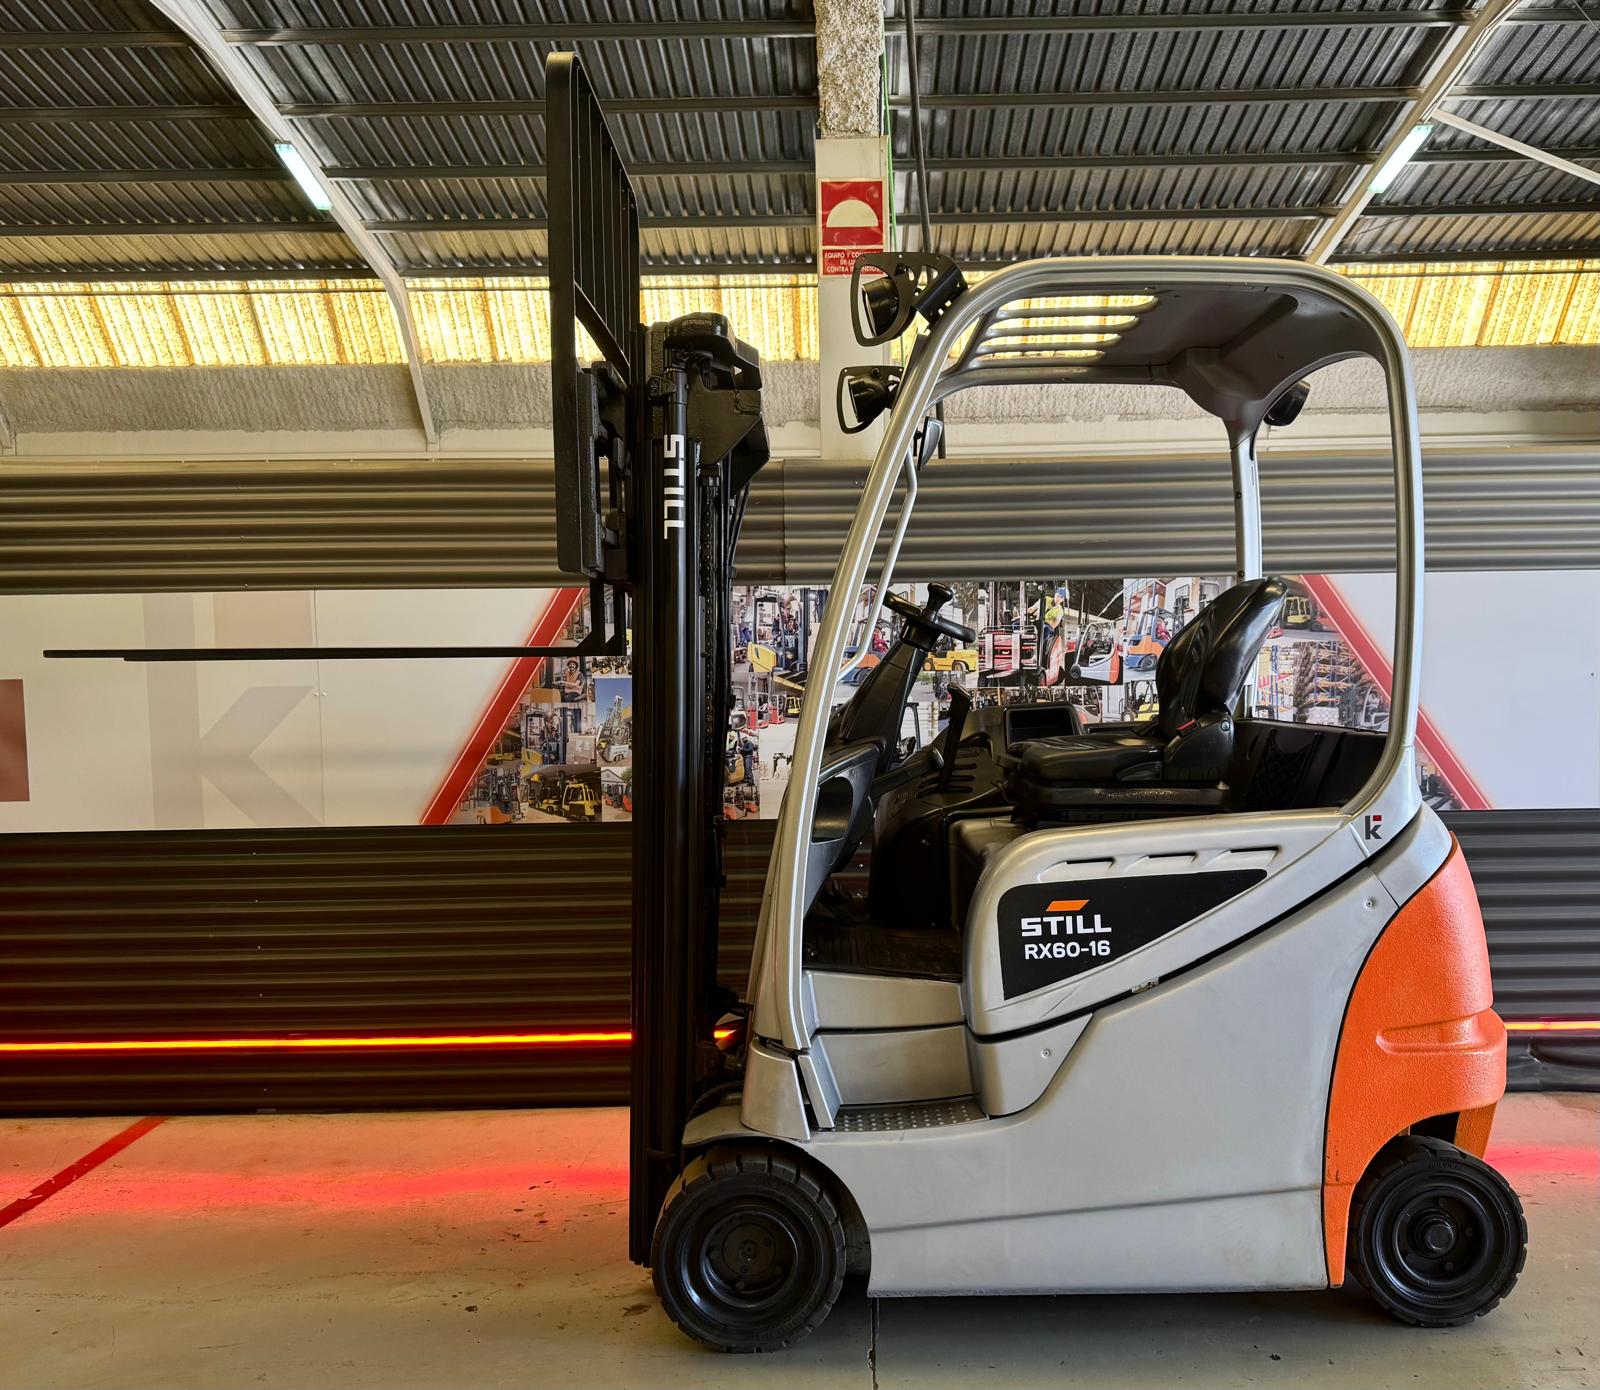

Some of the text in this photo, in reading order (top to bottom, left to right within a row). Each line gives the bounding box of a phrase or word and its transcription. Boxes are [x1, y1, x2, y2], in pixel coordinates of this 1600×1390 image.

[663, 434, 685, 540] STILL
[1021, 914, 1112, 937] STILL
[1024, 940, 1111, 960] RX60-16
